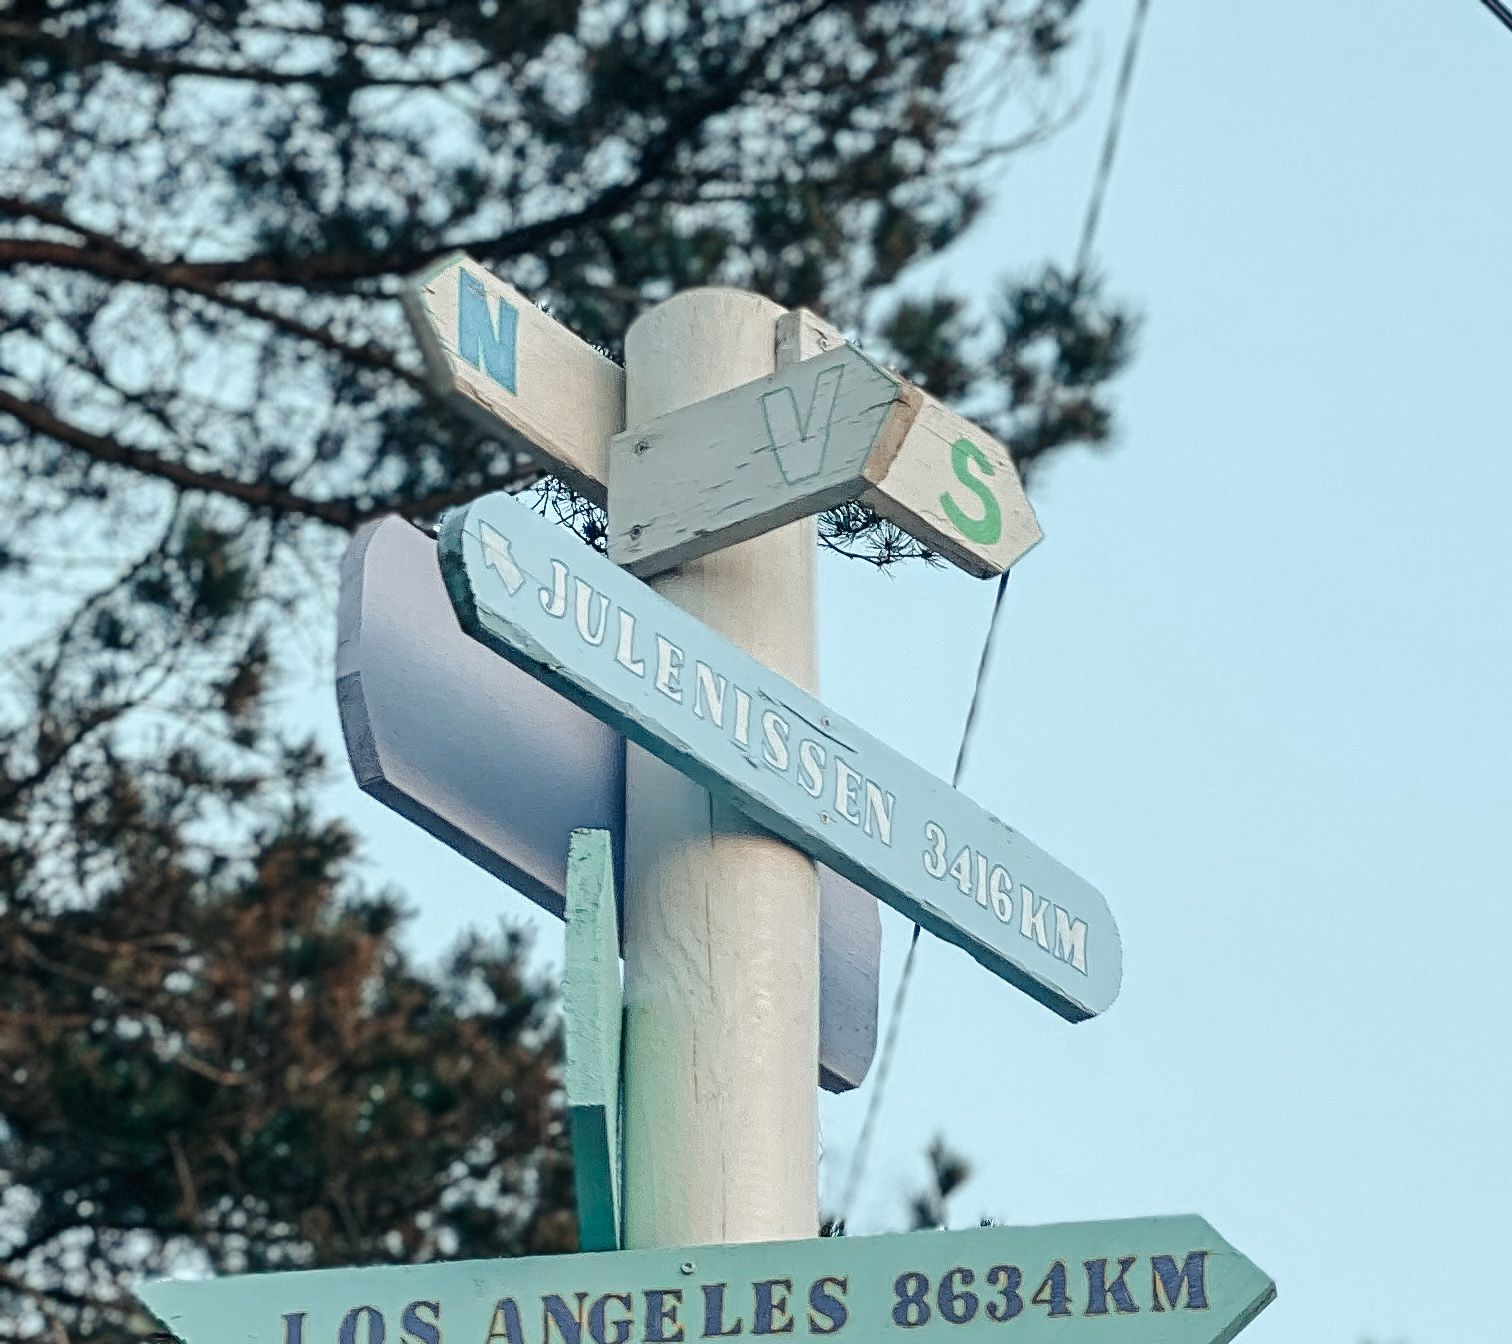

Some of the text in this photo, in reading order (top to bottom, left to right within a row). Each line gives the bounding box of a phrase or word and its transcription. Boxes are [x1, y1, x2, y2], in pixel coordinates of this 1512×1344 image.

[458, 267, 517, 396] N
[761, 364, 845, 483] V
[941, 437, 1002, 545] S
[538, 558, 896, 850] JULENISSEN
[892, 1249, 1209, 1328] 8634KM
